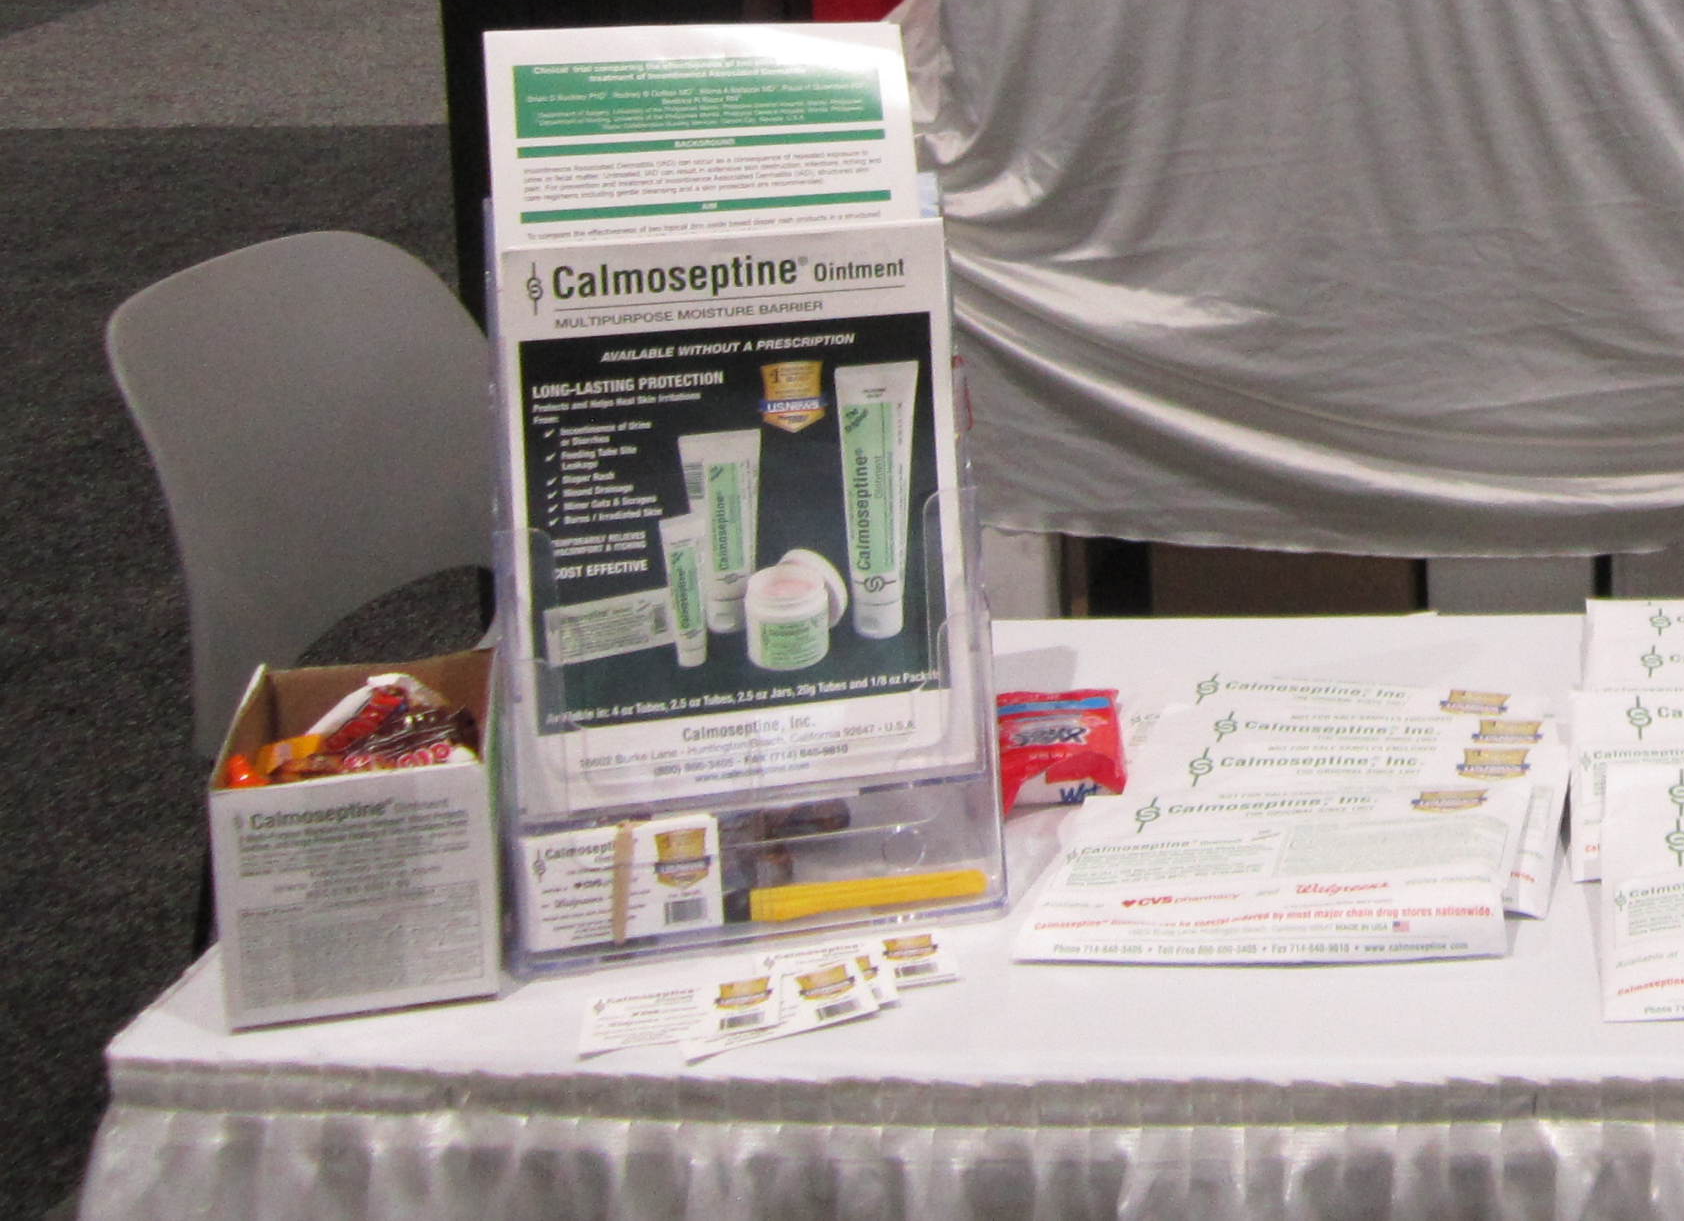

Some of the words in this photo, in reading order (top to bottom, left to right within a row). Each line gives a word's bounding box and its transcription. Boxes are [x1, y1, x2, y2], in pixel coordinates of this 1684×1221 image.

[812, 258, 906, 283] Ointment
[554, 310, 674, 329] MULTIPURPOSE
[676, 304, 756, 320] MOISTURE
[758, 299, 823, 316] BARRIER
[599, 345, 675, 363] AVAILABLE
[677, 340, 741, 357] WITHOUT
[741, 340, 753, 352] A
[755, 332, 855, 351] PRESCRIPTION
[531, 377, 635, 399] LONG-LASTING
[637, 370, 724, 391] PROTECTION
[587, 558, 648, 578] EFFECTIVE
[1138, 896, 1173, 908] CVS
[1174, 891, 1241, 904] pharmacy
